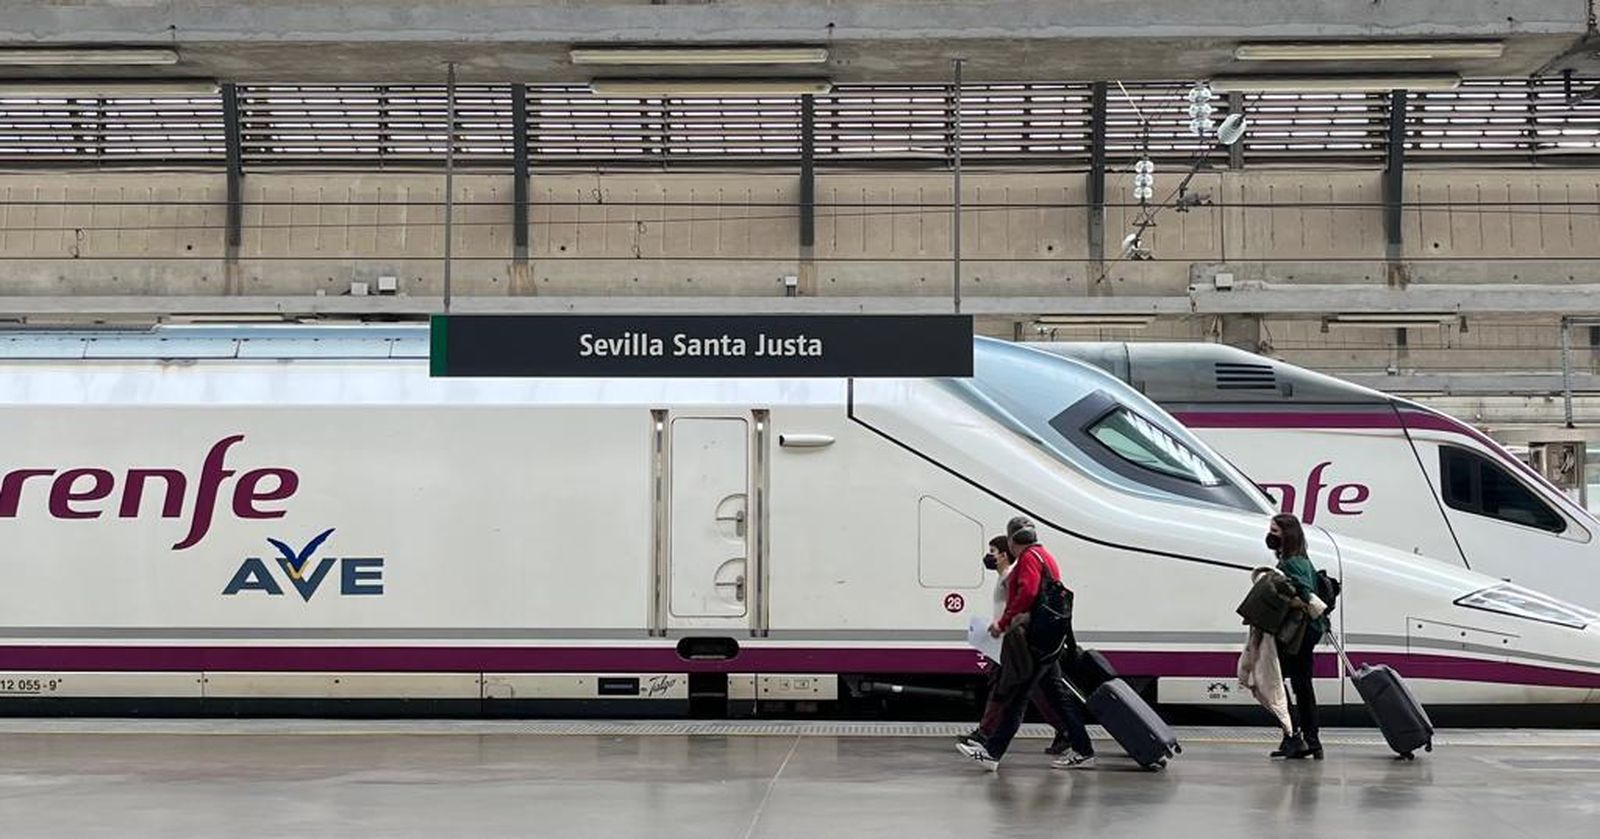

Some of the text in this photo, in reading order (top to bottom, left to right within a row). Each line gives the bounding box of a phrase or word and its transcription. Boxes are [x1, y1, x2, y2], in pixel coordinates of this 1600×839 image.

[579, 332, 823, 356] Sevilla Santa Justa
[0, 434, 300, 550] renfe
[1259, 461, 1370, 525] nfe
[221, 528, 384, 602] AVE
[946, 596, 962, 610] 28
